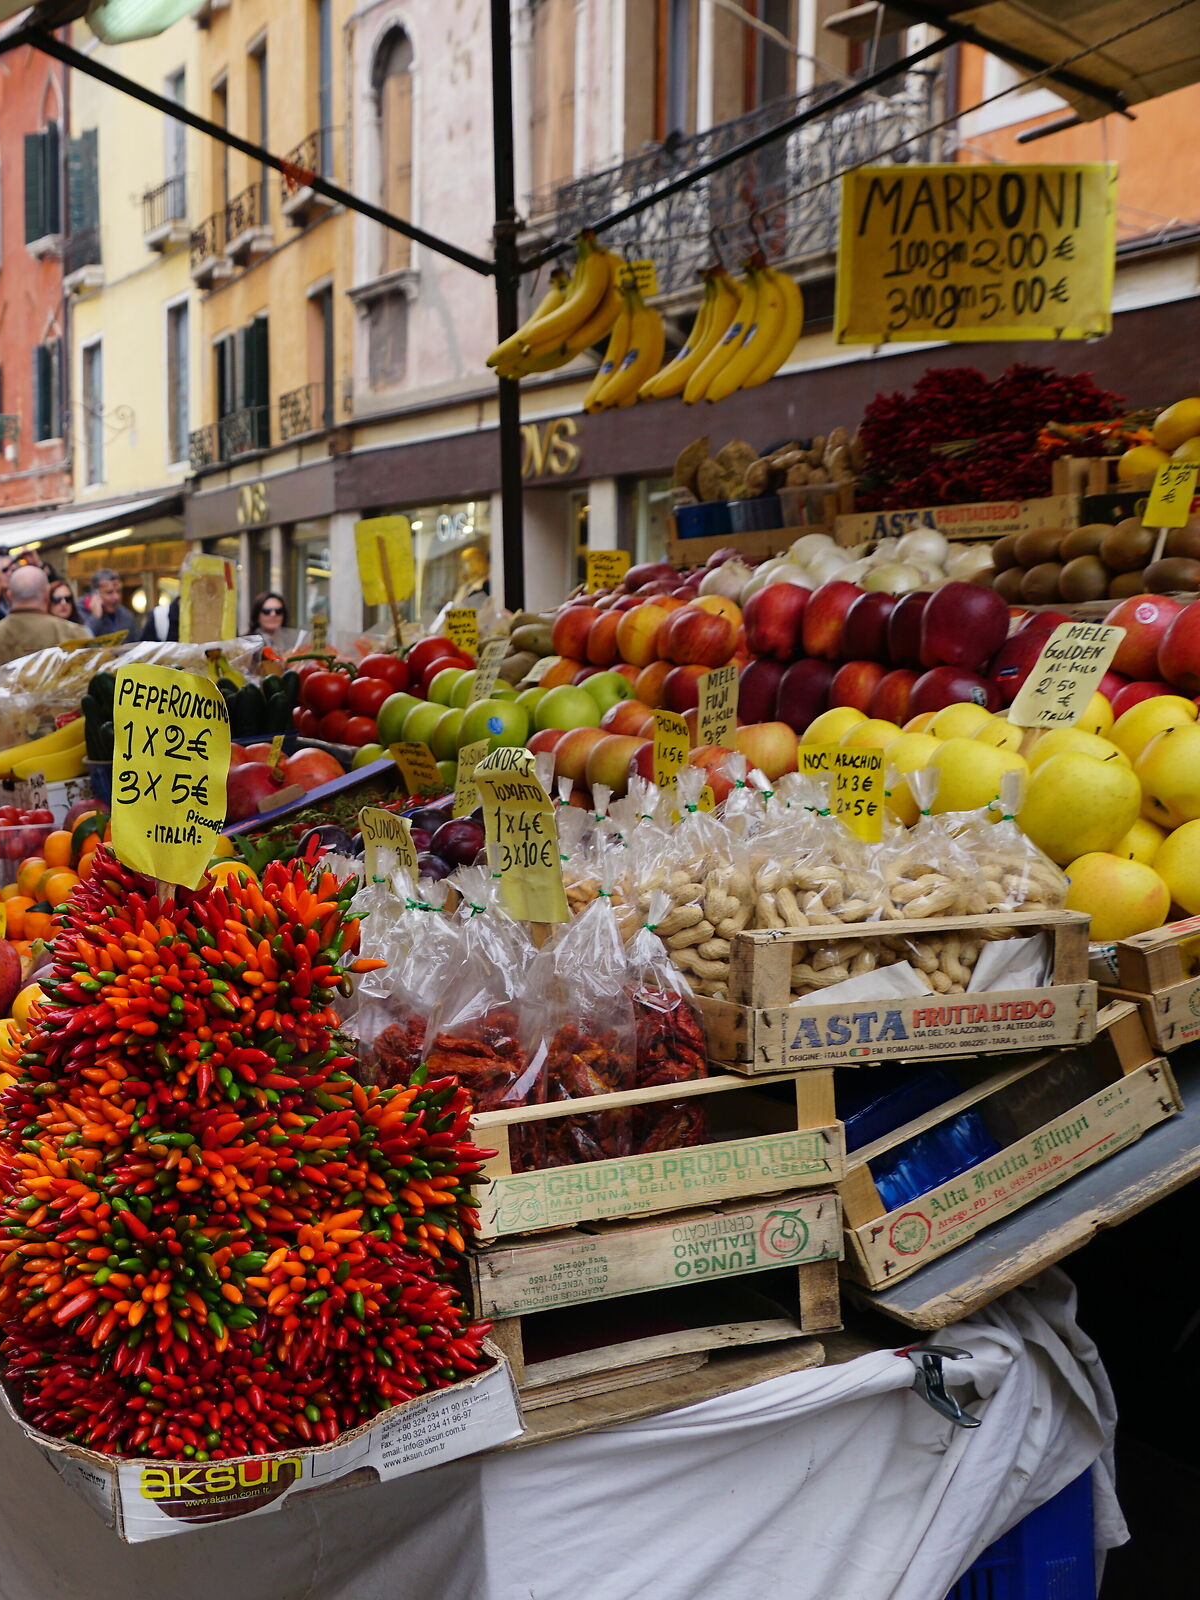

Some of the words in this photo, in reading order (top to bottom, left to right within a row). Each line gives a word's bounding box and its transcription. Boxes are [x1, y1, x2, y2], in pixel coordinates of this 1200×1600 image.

[857, 171, 1083, 237] MARRONI
[1066, 625, 1115, 642] MELE
[707, 665, 736, 690] MELE
[705, 687, 729, 711] FUJI
[1037, 710, 1076, 721] ITALIA
[834, 753, 882, 770] ARACHIDI
[485, 780, 542, 802] TOMATO
[790, 1010, 909, 1049] ASTA
[912, 1000, 1056, 1028] FRUTTALTEDO
[913, 1027, 926, 1037] VIA
[928, 1027, 942, 1036] DEL
[824, 1051, 847, 1059] ITALIA
[548, 1163, 654, 1197] GRUPPO
[662, 1136, 821, 1179] PRODUTTORI
[930, 1187, 969, 1219] Alta
[972, 1153, 1029, 1194] Frutta
[1031, 1113, 1090, 1160] Filippi
[550, 1188, 629, 1208] MADONNA
[736, 1170, 751, 1180] DI
[761, 1161, 821, 1176] CESENA
[672, 1215, 754, 1243] CERTIFICATO
[938, 1210, 968, 1230] Arsego
[674, 1232, 756, 1258] ITALIANO
[675, 1248, 756, 1278] FUNGO
[513, 1294, 558, 1308] BISPORUS
[561, 1285, 605, 1297] AGARICUS
[397, 1423, 411, 1435] +90
[413, 1416, 426, 1428] 324
[427, 1411, 440, 1421] 234
[441, 1405, 449, 1416] 41
[451, 1402, 460, 1412] 90
[402, 1406, 429, 1422] MERSIN
[381, 1440, 394, 1450] Fax:
[397, 1433, 412, 1445] +90
[413, 1427, 426, 1439] 324
[427, 1421, 440, 1433] 234
[442, 1416, 450, 1427] 41
[452, 1409, 472, 1422] 96-97
[382, 1447, 402, 1459] email:
[403, 1423, 467, 1452] info@aksun.com.tr
[383, 1442, 446, 1470] www.aksun.com.tr
[139, 1457, 302, 1499] aksun
[184, 1487, 270, 1508] www.aksun.com.tr
